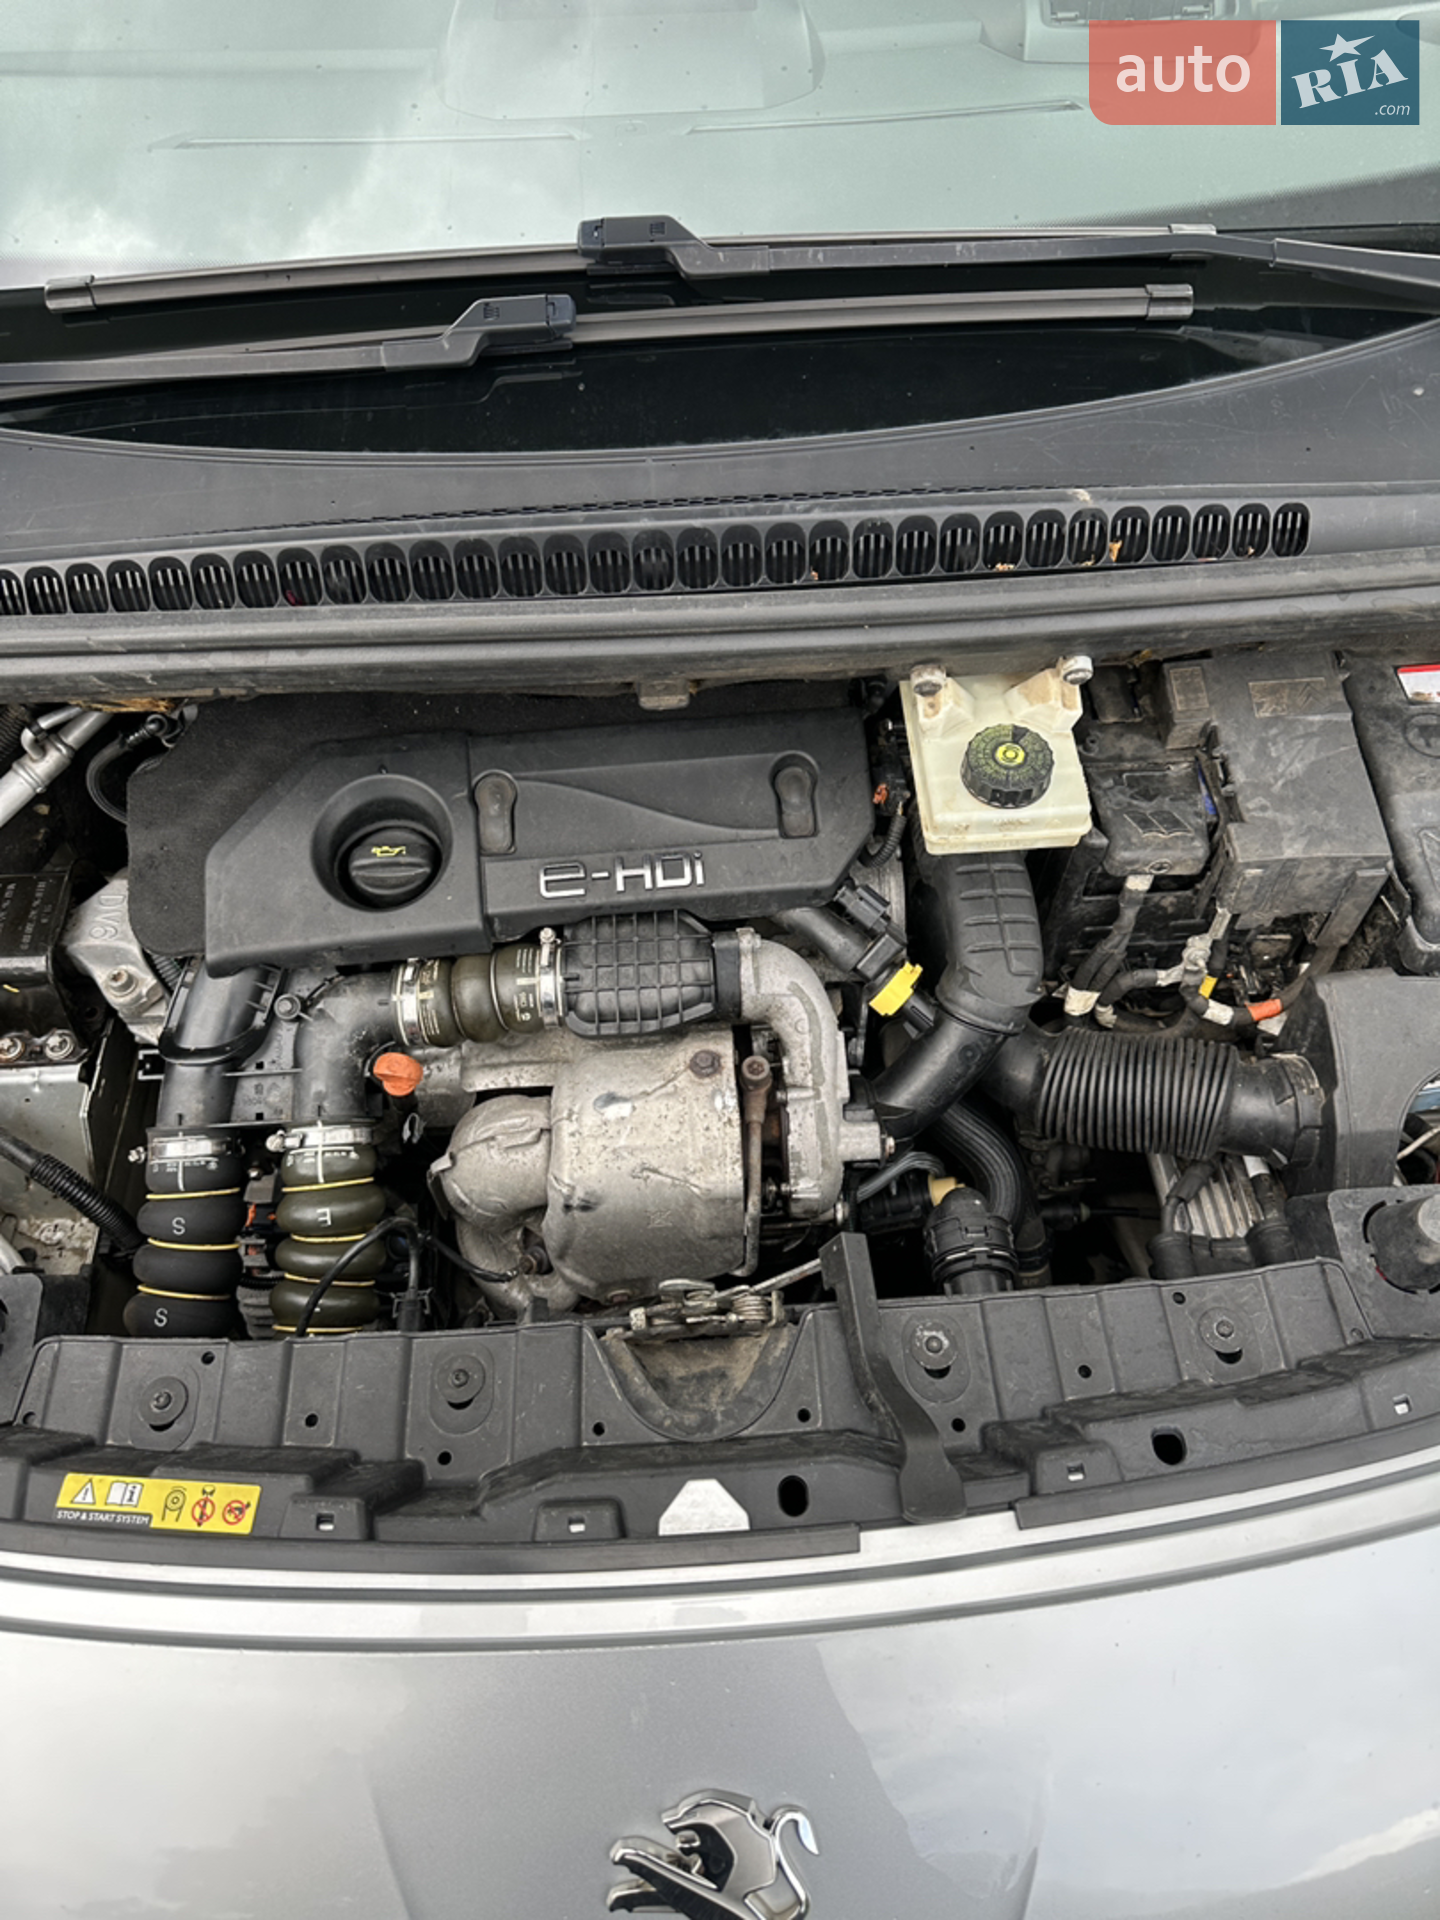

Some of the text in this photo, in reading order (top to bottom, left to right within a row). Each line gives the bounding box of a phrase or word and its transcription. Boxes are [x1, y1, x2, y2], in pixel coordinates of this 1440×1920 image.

[539, 852, 705, 899] e-HDi
[89, 894, 127, 940] DV6
[172, 1217, 186, 1236] S
[154, 1308, 169, 1328] S
[57, 1510, 150, 1525] STOP & START SYSTEM
